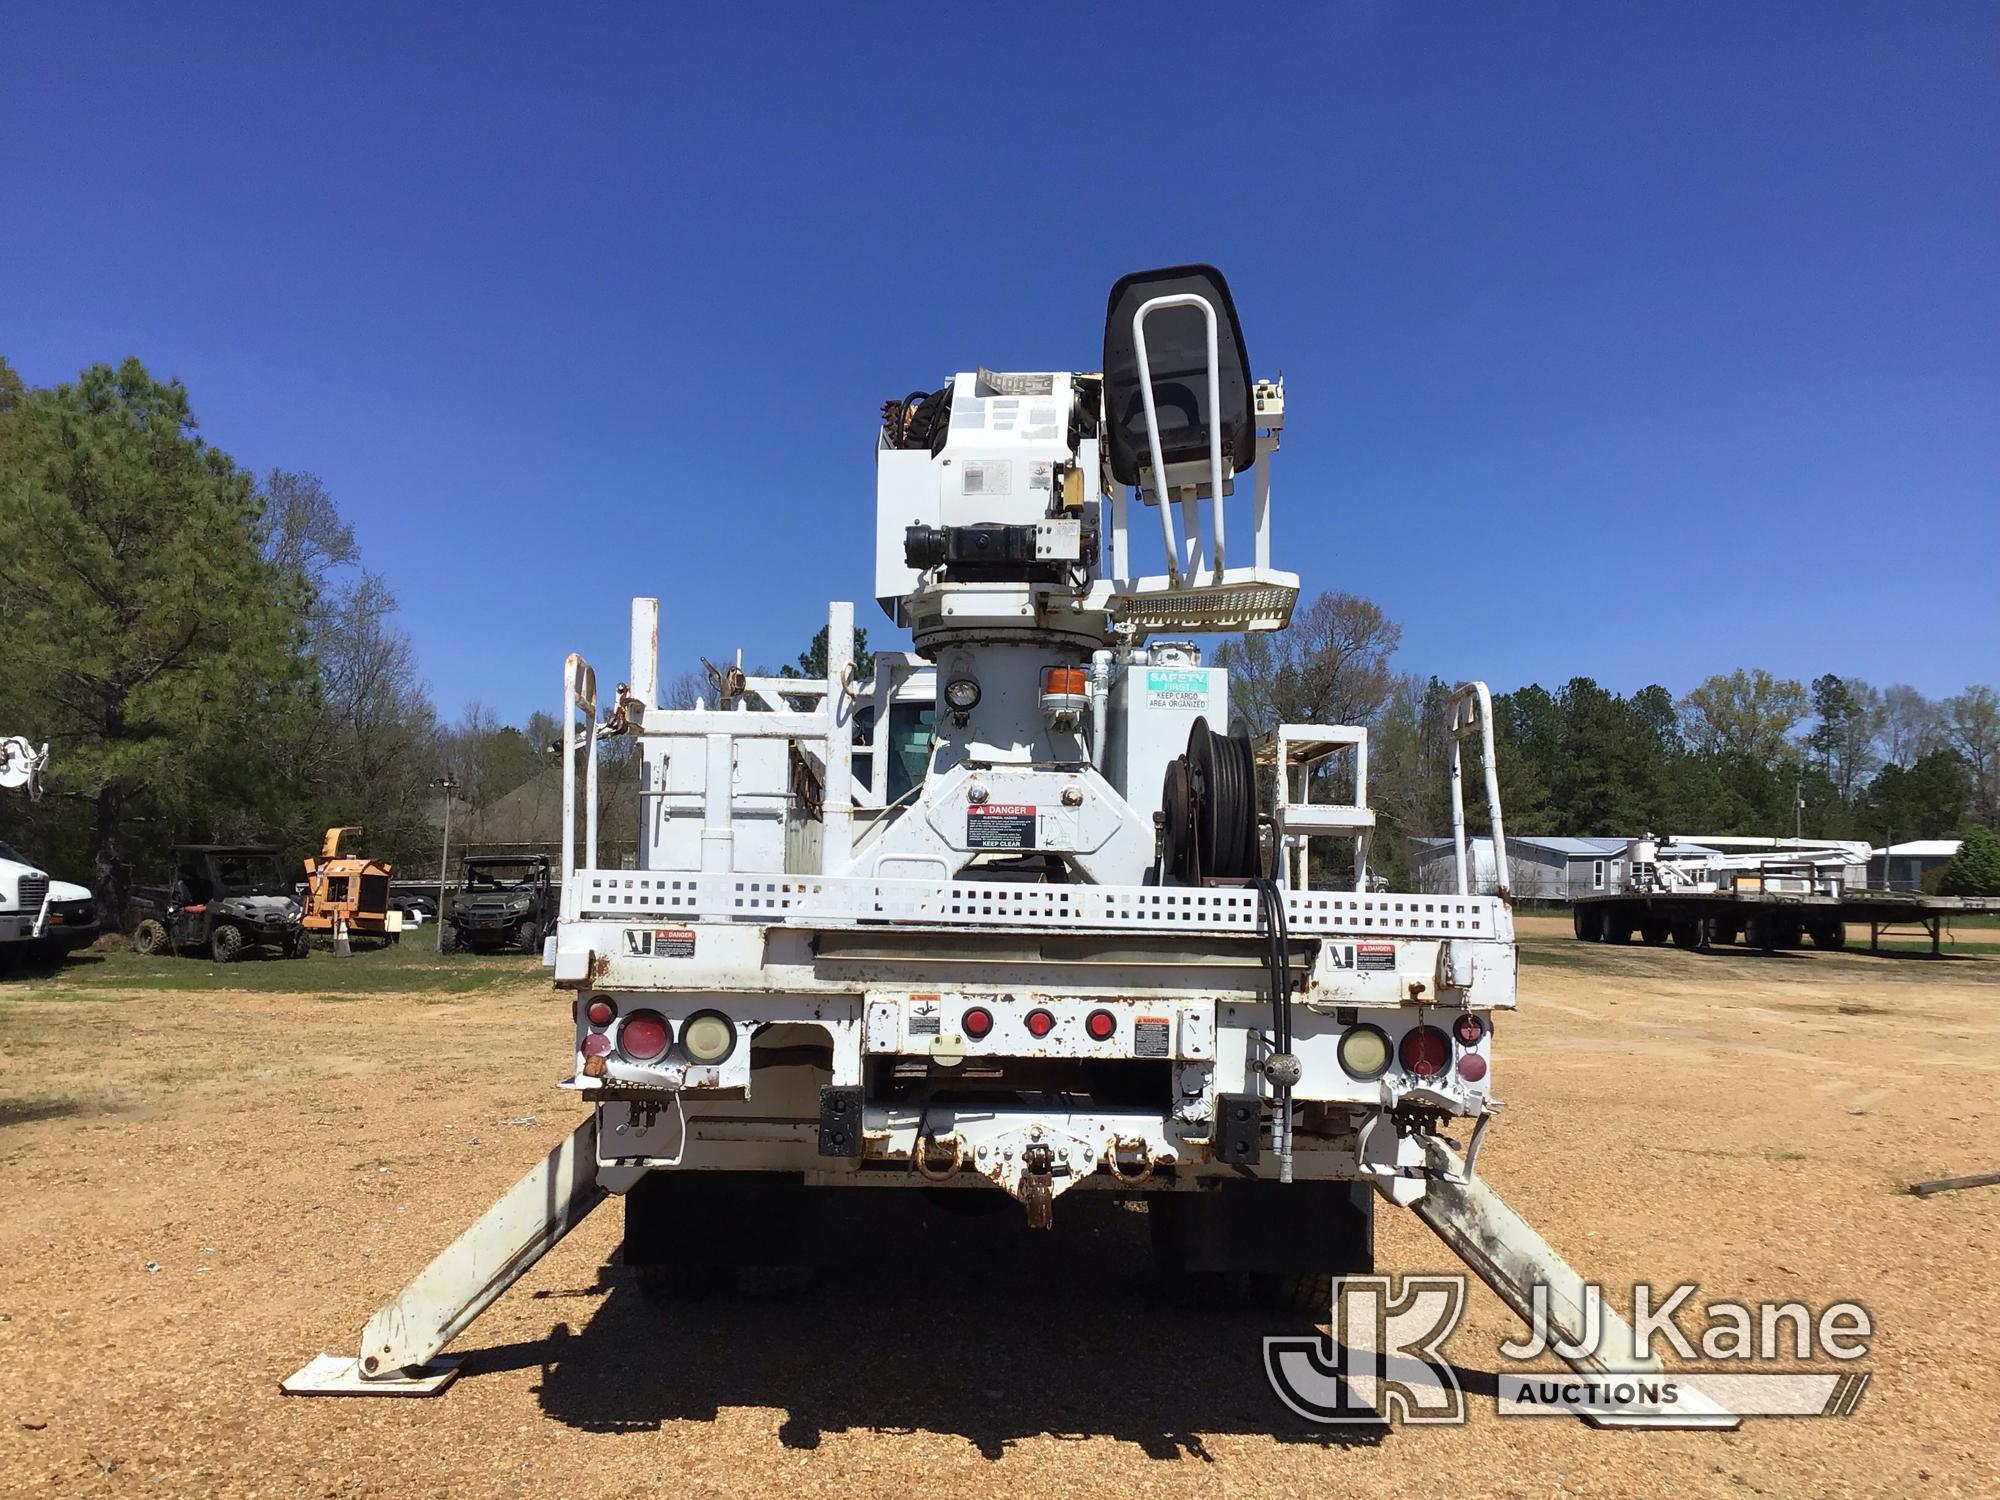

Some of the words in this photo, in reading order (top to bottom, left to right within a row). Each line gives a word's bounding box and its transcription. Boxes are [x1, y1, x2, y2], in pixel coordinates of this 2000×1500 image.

[1150, 672, 1206, 683] SAFETY
[1168, 700, 1206, 708] ORGANIZED
[989, 806, 1026, 814] DANGER
